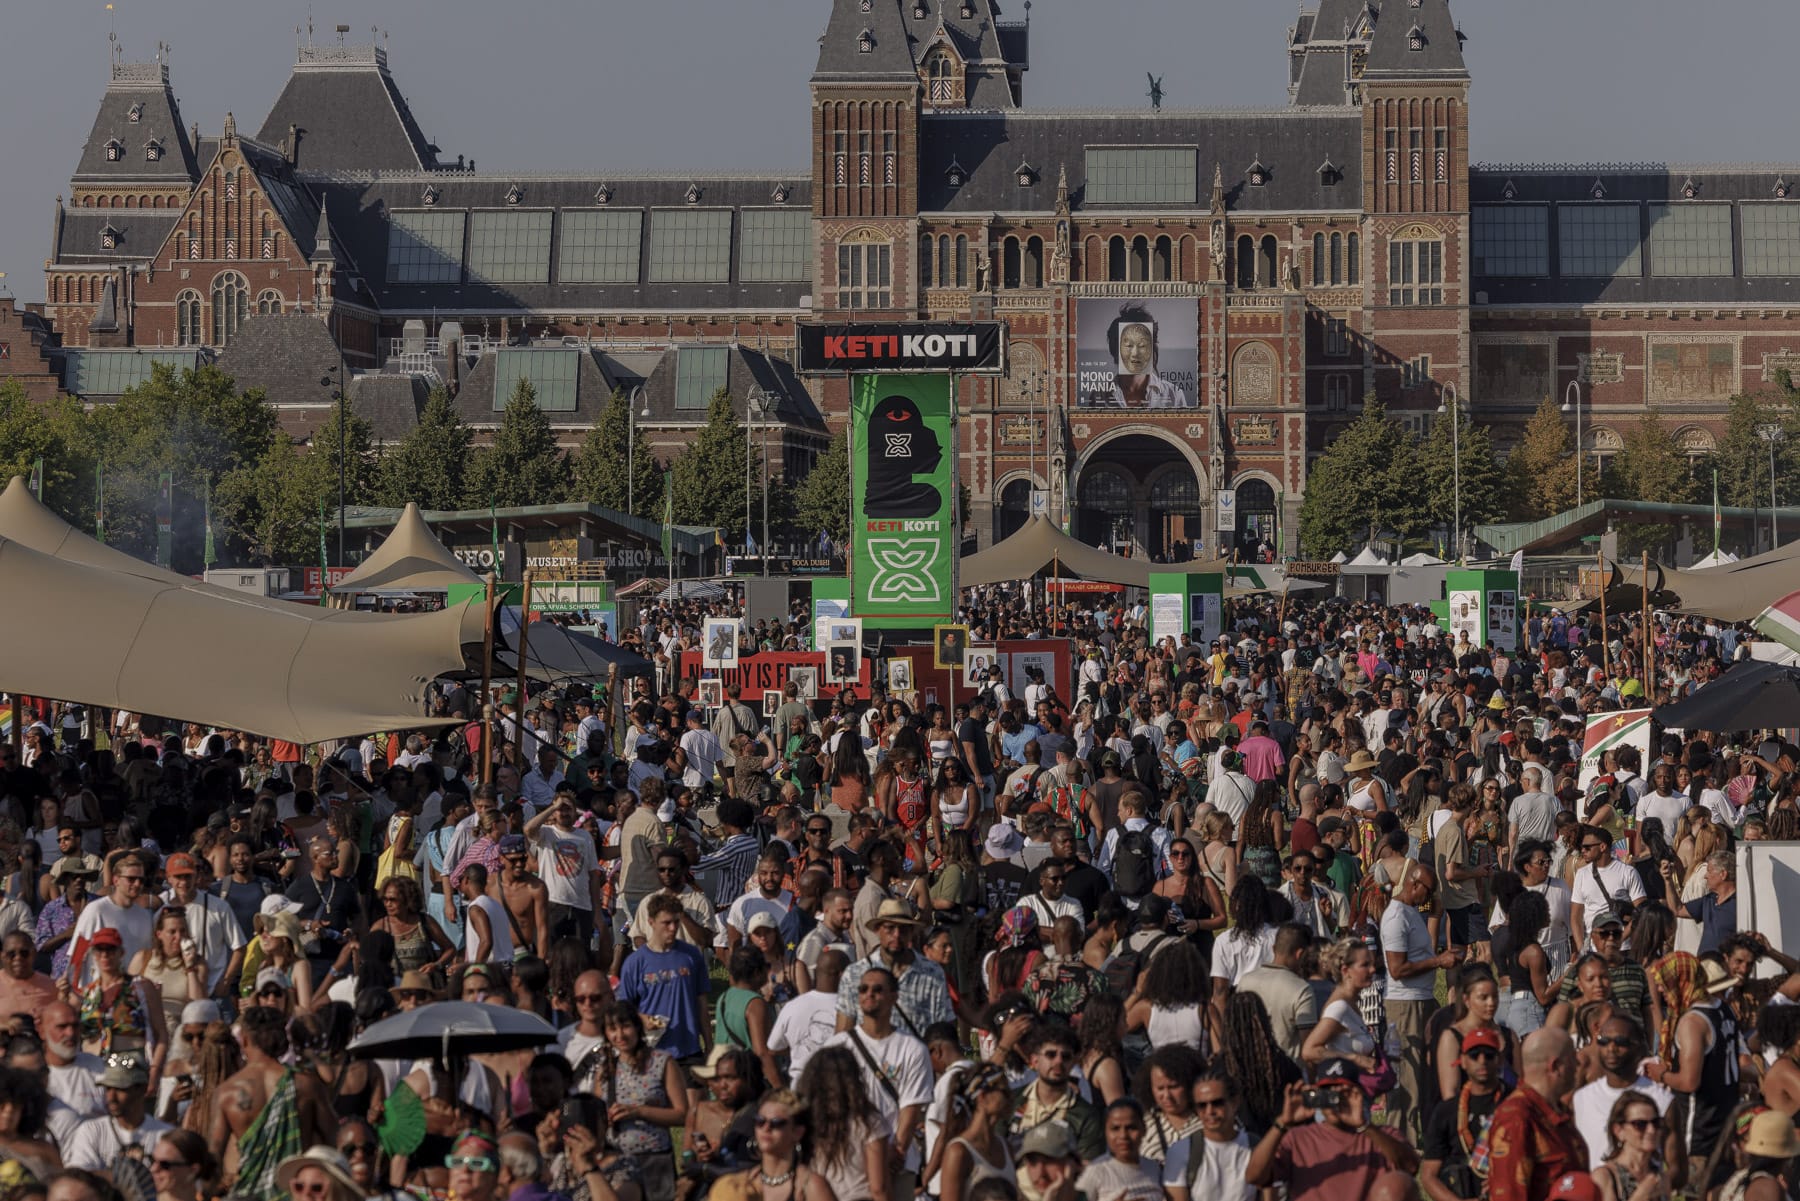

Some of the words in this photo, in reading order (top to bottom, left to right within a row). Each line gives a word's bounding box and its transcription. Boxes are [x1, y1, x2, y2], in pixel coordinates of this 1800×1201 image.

[824, 335, 898, 359] KETI
[902, 334, 977, 358] KOTI
[1080, 371, 1114, 382] MONO
[1160, 371, 1194, 381] FIONA
[1080, 381, 1117, 392] MANIA
[1171, 381, 1193, 392] TAN
[867, 520, 903, 532] KETI
[904, 520, 940, 532] KOTI
[526, 557, 578, 567] MUSEUM
[757, 663, 772, 689] IS
